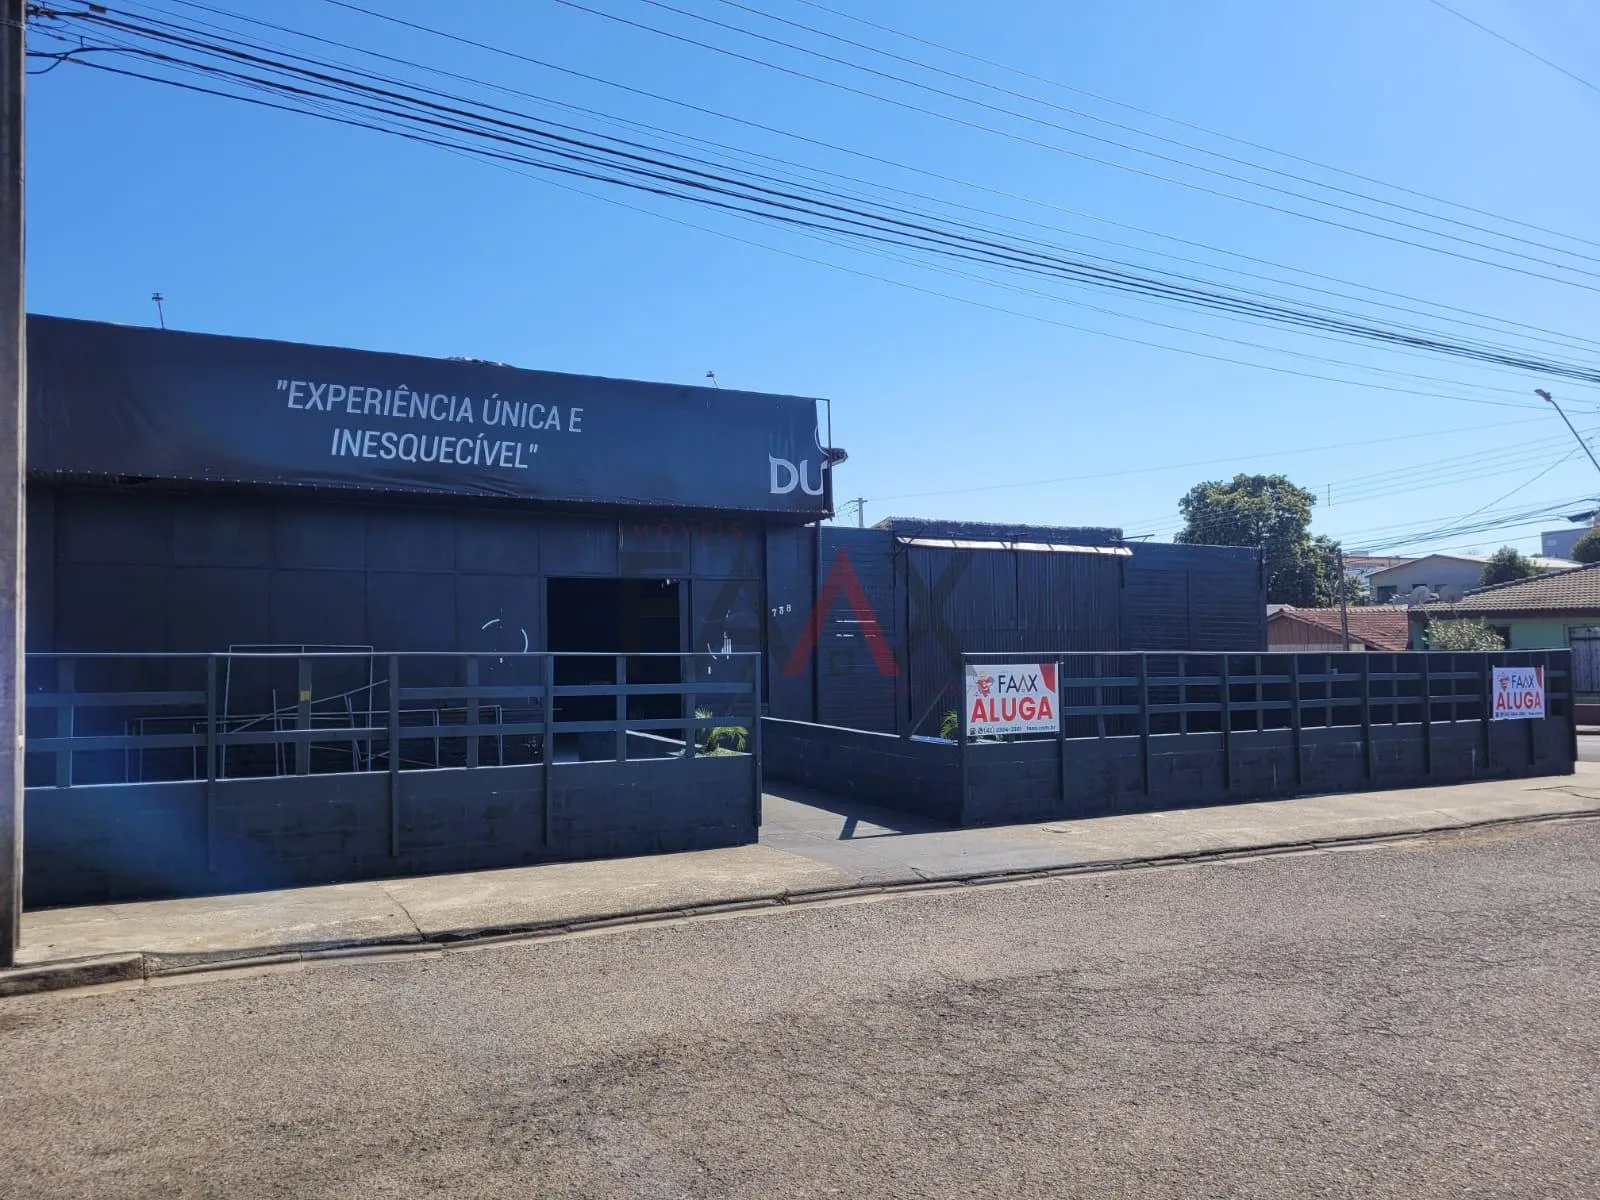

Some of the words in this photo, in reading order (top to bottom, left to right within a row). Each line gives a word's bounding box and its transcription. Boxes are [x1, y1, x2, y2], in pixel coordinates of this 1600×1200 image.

[277, 379, 474, 424] "EXPERIÊNCIA
[482, 392, 561, 431] ÚNICA
[568, 407, 584, 433] E
[331, 428, 538, 469] INESQUECÍVEL"
[970, 696, 1053, 723] ALUGA
[1496, 691, 1541, 710] ALUGA
